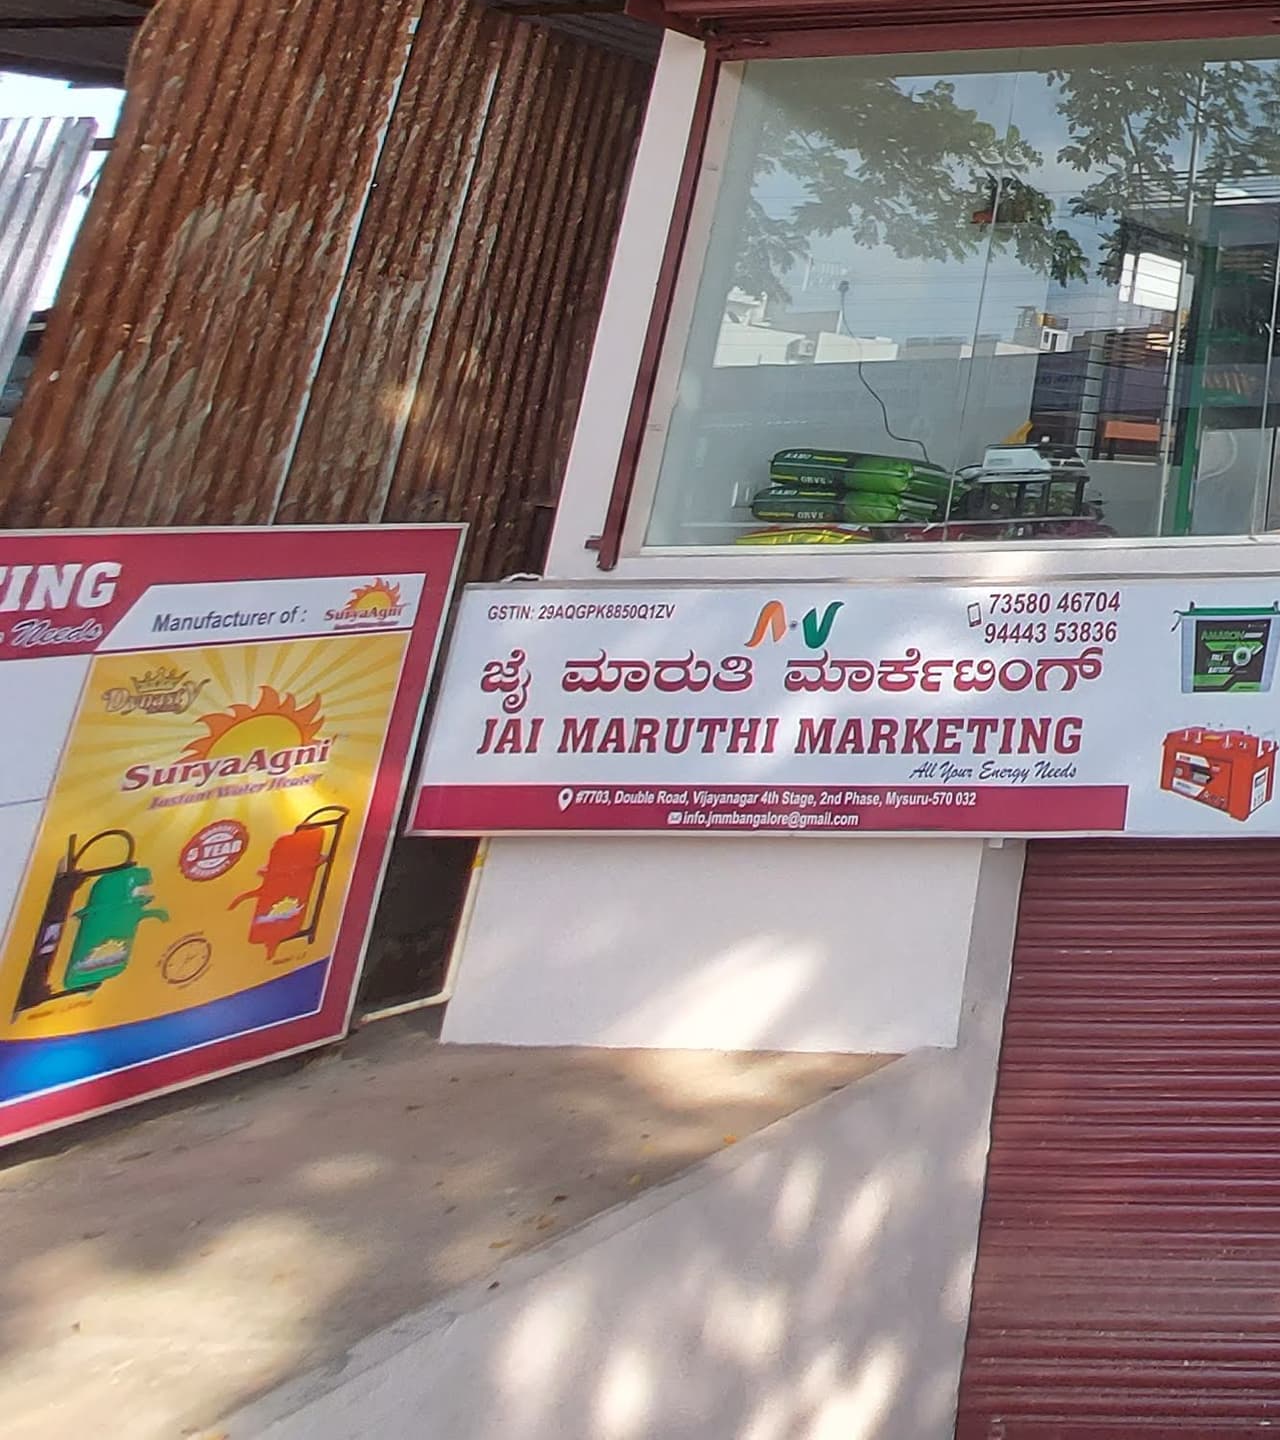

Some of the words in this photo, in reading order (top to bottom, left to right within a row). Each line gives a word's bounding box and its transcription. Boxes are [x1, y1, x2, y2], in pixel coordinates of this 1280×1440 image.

[0, 562, 123, 611] ING
[488, 605, 534, 621] GSTIN:
[988, 592, 1051, 615] 73580
[1056, 591, 1121, 614] 46704
[11, 617, 104, 647] Needs
[152, 606, 276, 634] Manufacturer
[278, 607, 299, 625] of
[984, 622, 1048, 645] 94443
[1053, 620, 1118, 643] 53836
[480, 649, 532, 714] ಜೈ
[561, 648, 756, 694] ಮಾರುತಿ
[476, 717, 545, 755] JAI
[556, 717, 780, 755] MARUTHI
[794, 716, 1084, 756] MARKETING
[121, 737, 331, 794] SuryaAgni
[908, 761, 936, 779] All
[940, 761, 973, 784] Your
[978, 759, 1032, 783] Energy
[1033, 760, 1077, 780] Needs
[575, 790, 612, 806] #7703,
[614, 790, 655, 805] Double
[656, 790, 689, 807] Road,
[692, 791, 760, 809] Vijayanagar
[760, 791, 779, 805] 4th
[781, 791, 817, 808] Stage,
[819, 791, 842, 805] 2nd
[843, 791, 883, 808] Phase,
[885, 791, 953, 809] Mysuru-570
[955, 791, 977, 806] 032
[682, 810, 859, 829] info.jmmbangalore@gmail.com
[202, 838, 243, 859] YEAR
